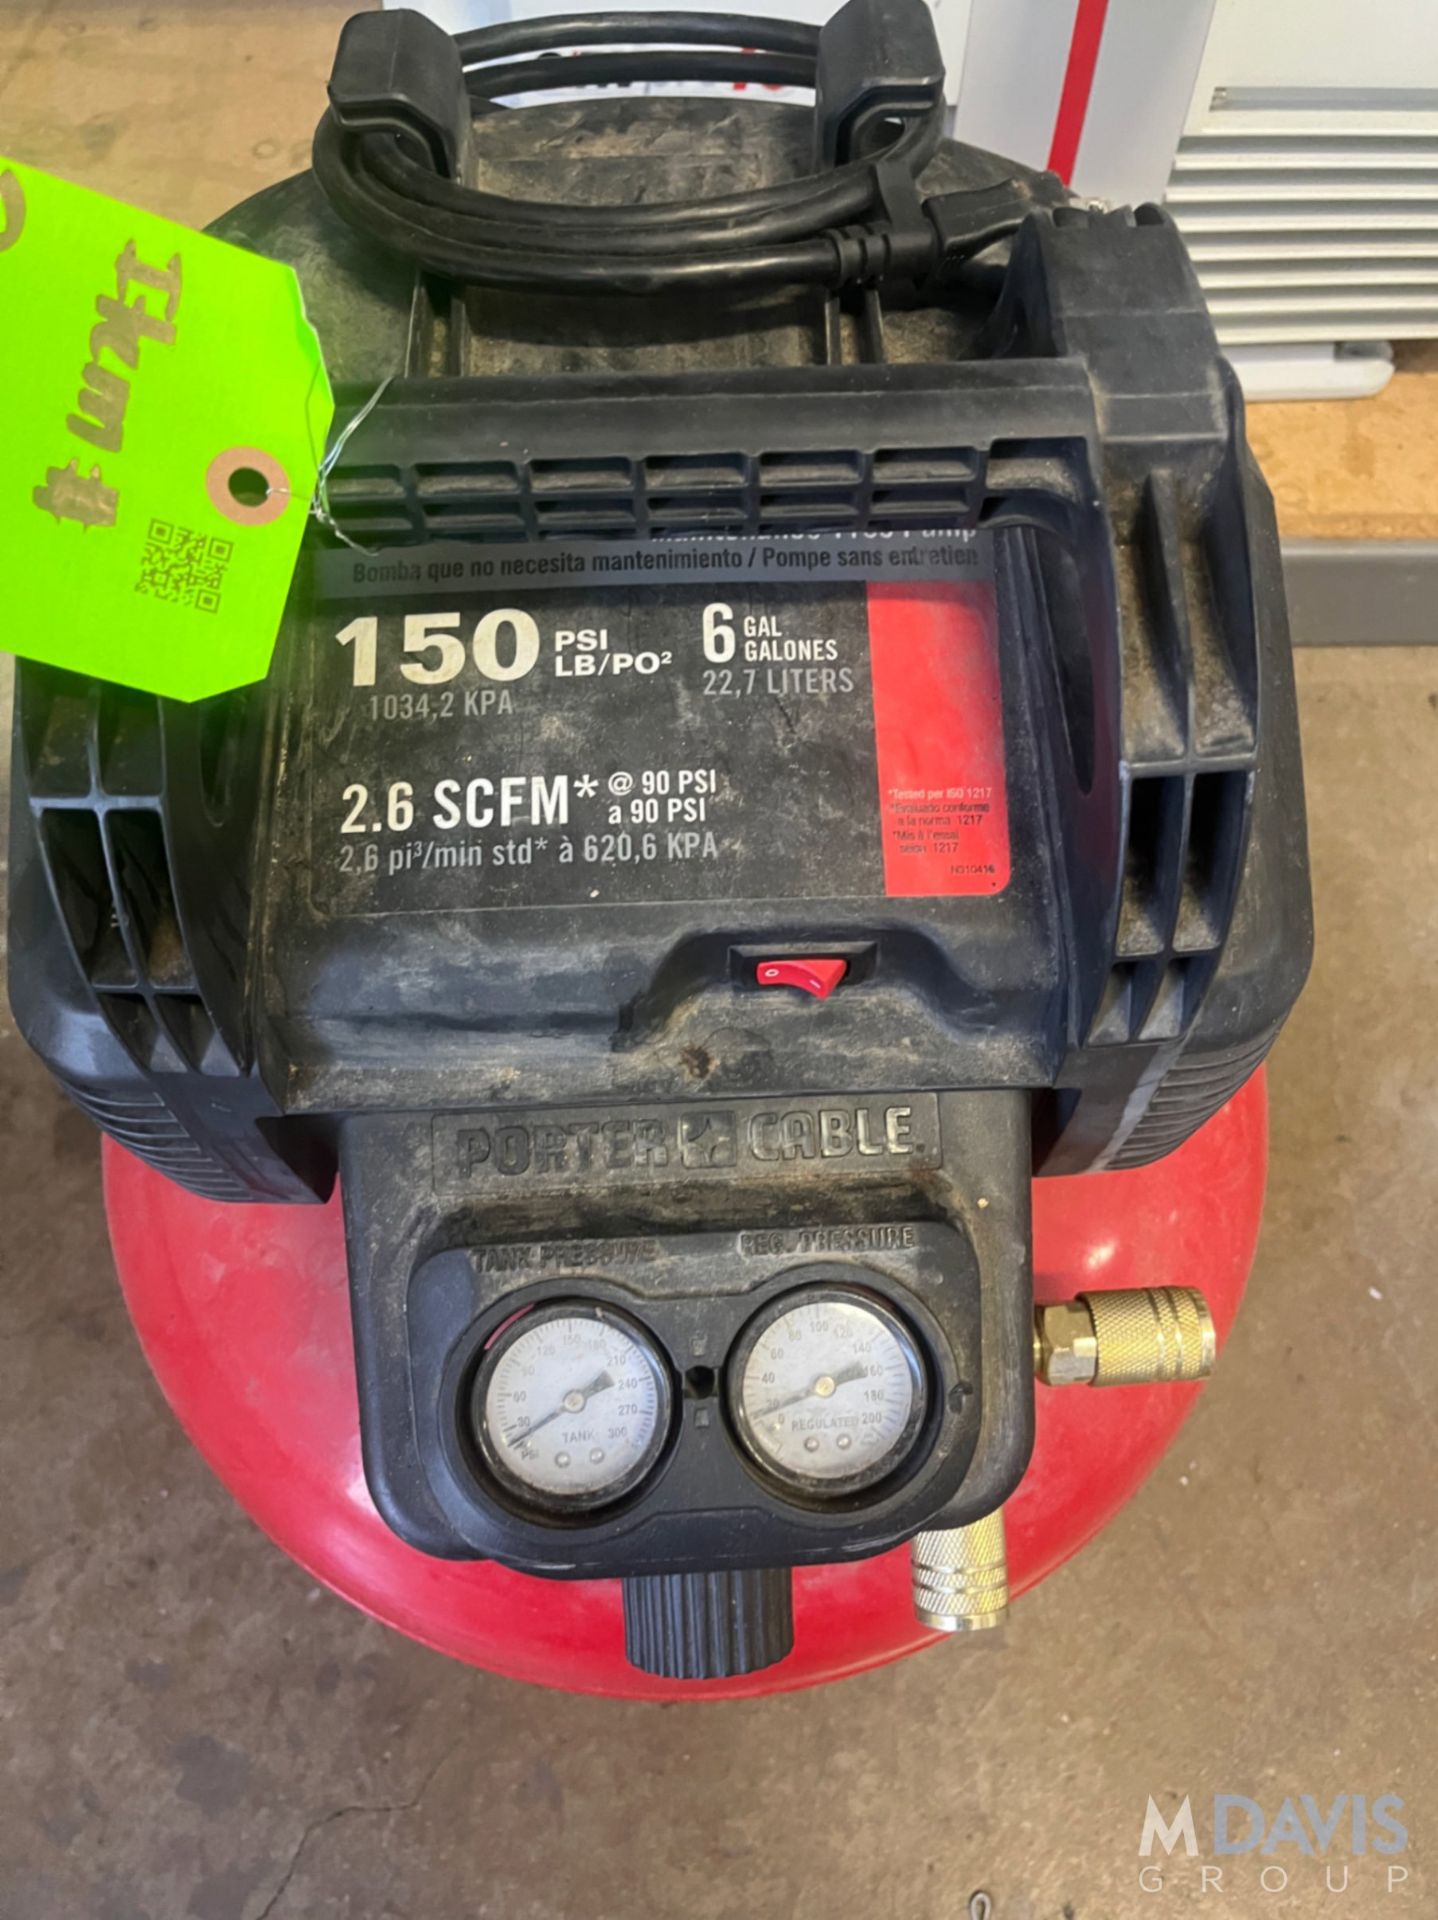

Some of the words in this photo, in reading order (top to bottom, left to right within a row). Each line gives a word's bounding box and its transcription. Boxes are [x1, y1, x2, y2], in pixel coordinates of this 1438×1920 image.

[353, 561, 420, 583] Bomba
[428, 562, 464, 581] que
[470, 557, 494, 577] no
[500, 553, 585, 575] necesita
[592, 548, 743, 571] mantenimiento
[762, 550, 831, 571] Pompe
[837, 549, 883, 566] sans
[888, 547, 979, 566] entretien
[702, 602, 736, 663] 6
[743, 616, 782, 638] GAL
[335, 608, 540, 687] 150
[555, 629, 608, 651] PSI
[744, 639, 838, 662] GALONES
[702, 669, 756, 698] 22,7
[767, 668, 854, 694] LITERS
[370, 692, 454, 721] 1034,2
[463, 690, 513, 716] KPA
[641, 771, 670, 795] 90
[678, 769, 717, 794] PSI
[967, 787, 992, 799] 1217
[341, 782, 414, 833] 2.6
[629, 799, 659, 823] 90
[667, 798, 706, 822] PSI
[957, 815, 983, 825] 1217
[339, 843, 379, 873] 2,6
[558, 838, 573, 863] à
[583, 833, 657, 866] 620,6
[667, 832, 718, 859] KPA
[933, 842, 958, 853] 1217
[456, 1119, 669, 1178] PORTER
[748, 1106, 913, 1162] CABLE
[474, 1246, 530, 1272] TANK
[809, 1321, 829, 1333] 100
[770, 1347, 784, 1360] 60
[852, 1342, 871, 1354] 140
[607, 1354, 626, 1367] 210
[761, 1372, 775, 1384] 40
[864, 1366, 884, 1378] 160
[618, 1378, 638, 1391] 240
[513, 1391, 527, 1402] 60
[864, 1390, 884, 1402] 180
[618, 1405, 637, 1416] 270
[517, 1416, 530, 1427] 30
[792, 1416, 858, 1432] REGULATED
[862, 1413, 882, 1425] 200
[562, 1430, 596, 1443] TANK
[607, 1428, 628, 1440] 300
